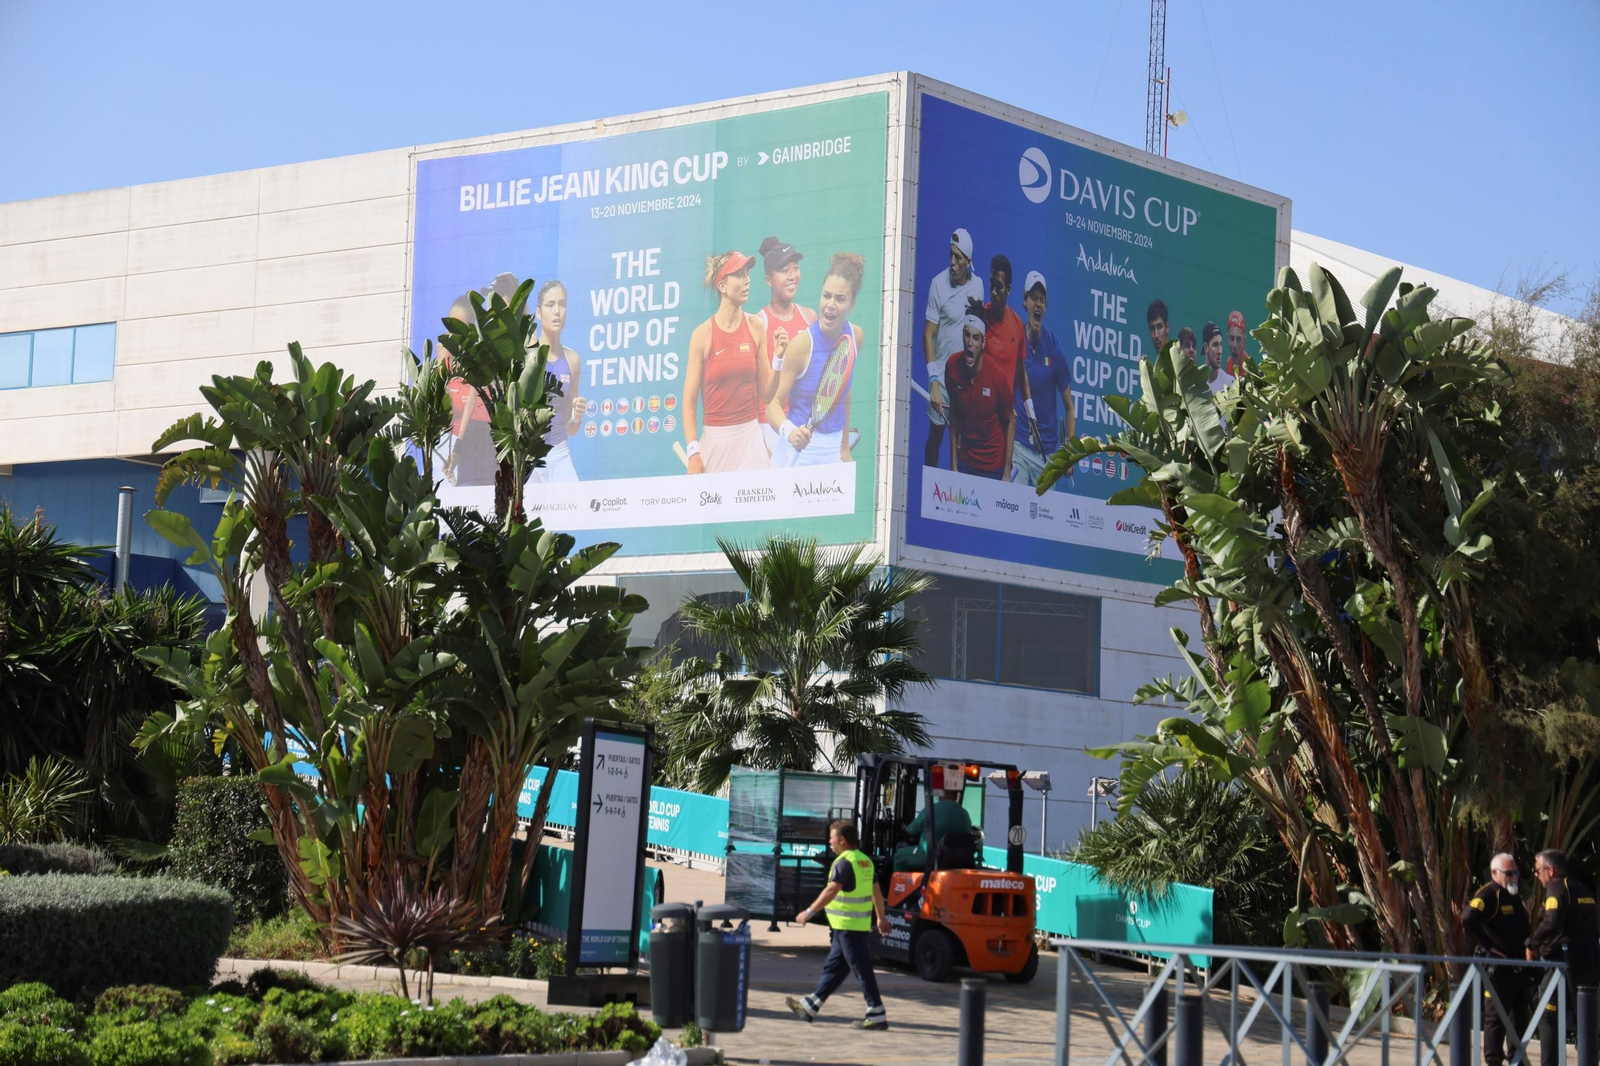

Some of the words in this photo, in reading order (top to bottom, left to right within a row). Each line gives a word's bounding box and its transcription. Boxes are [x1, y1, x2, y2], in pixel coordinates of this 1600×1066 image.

[459, 178, 531, 212] BILLIE
[534, 168, 600, 203] JEAN
[605, 160, 669, 194] KING
[673, 151, 729, 185] CUP
[737, 155, 750, 167] BY
[772, 136, 851, 165] GAINBRIDGE
[590, 205, 616, 219] 13-20
[617, 197, 675, 216] NOVIEMBRE
[676, 193, 702, 208] 2024
[1060, 167, 1136, 219] DAVIS
[1143, 196, 1199, 236] CUP
[1065, 212, 1086, 230] 19-24
[1087, 219, 1133, 244] NOVIEMBRE
[1133, 232, 1153, 249] 2024
[611, 247, 661, 280] THE
[1076, 242, 1139, 285] Andalucía
[590, 281, 680, 317] WORLD
[1090, 288, 1128, 324] THE
[589, 320, 640, 352] CUP
[645, 316, 679, 347] OF
[1073, 319, 1142, 362] WORLD
[586, 352, 679, 387] TENNIS
[1073, 355, 1112, 389] CUP
[1116, 366, 1141, 396] OF
[1070, 389, 1132, 430] TEN
[737, 487, 774, 496] FRANKLIN
[792, 479, 845, 498] Andalucía
[932, 482, 983, 511] Andalucía
[542, 502, 578, 512] MAGELLAN
[602, 497, 628, 508] Copilot
[661, 497, 687, 505] BURCH
[699, 490, 723, 507] Stake
[735, 494, 777, 504] TEMPLETON
[1122, 522, 1147, 536] UniCredit
[608, 754, 626, 764] PUERTAS
[629, 756, 641, 766] GATES
[528, 778, 540, 792] CUP
[605, 794, 623, 803] PUERTAS
[648, 800, 665, 816] ORLD
[665, 802, 680, 818] CUP
[1013, 828, 1023, 844] 20
[894, 883, 906, 892] 25
[980, 877, 1025, 890] mateco
[1035, 875, 1057, 894] CUP
[1115, 914, 1134, 926] DAVIS
[1135, 917, 1151, 928] CUP
[888, 928, 911, 940] ateco
